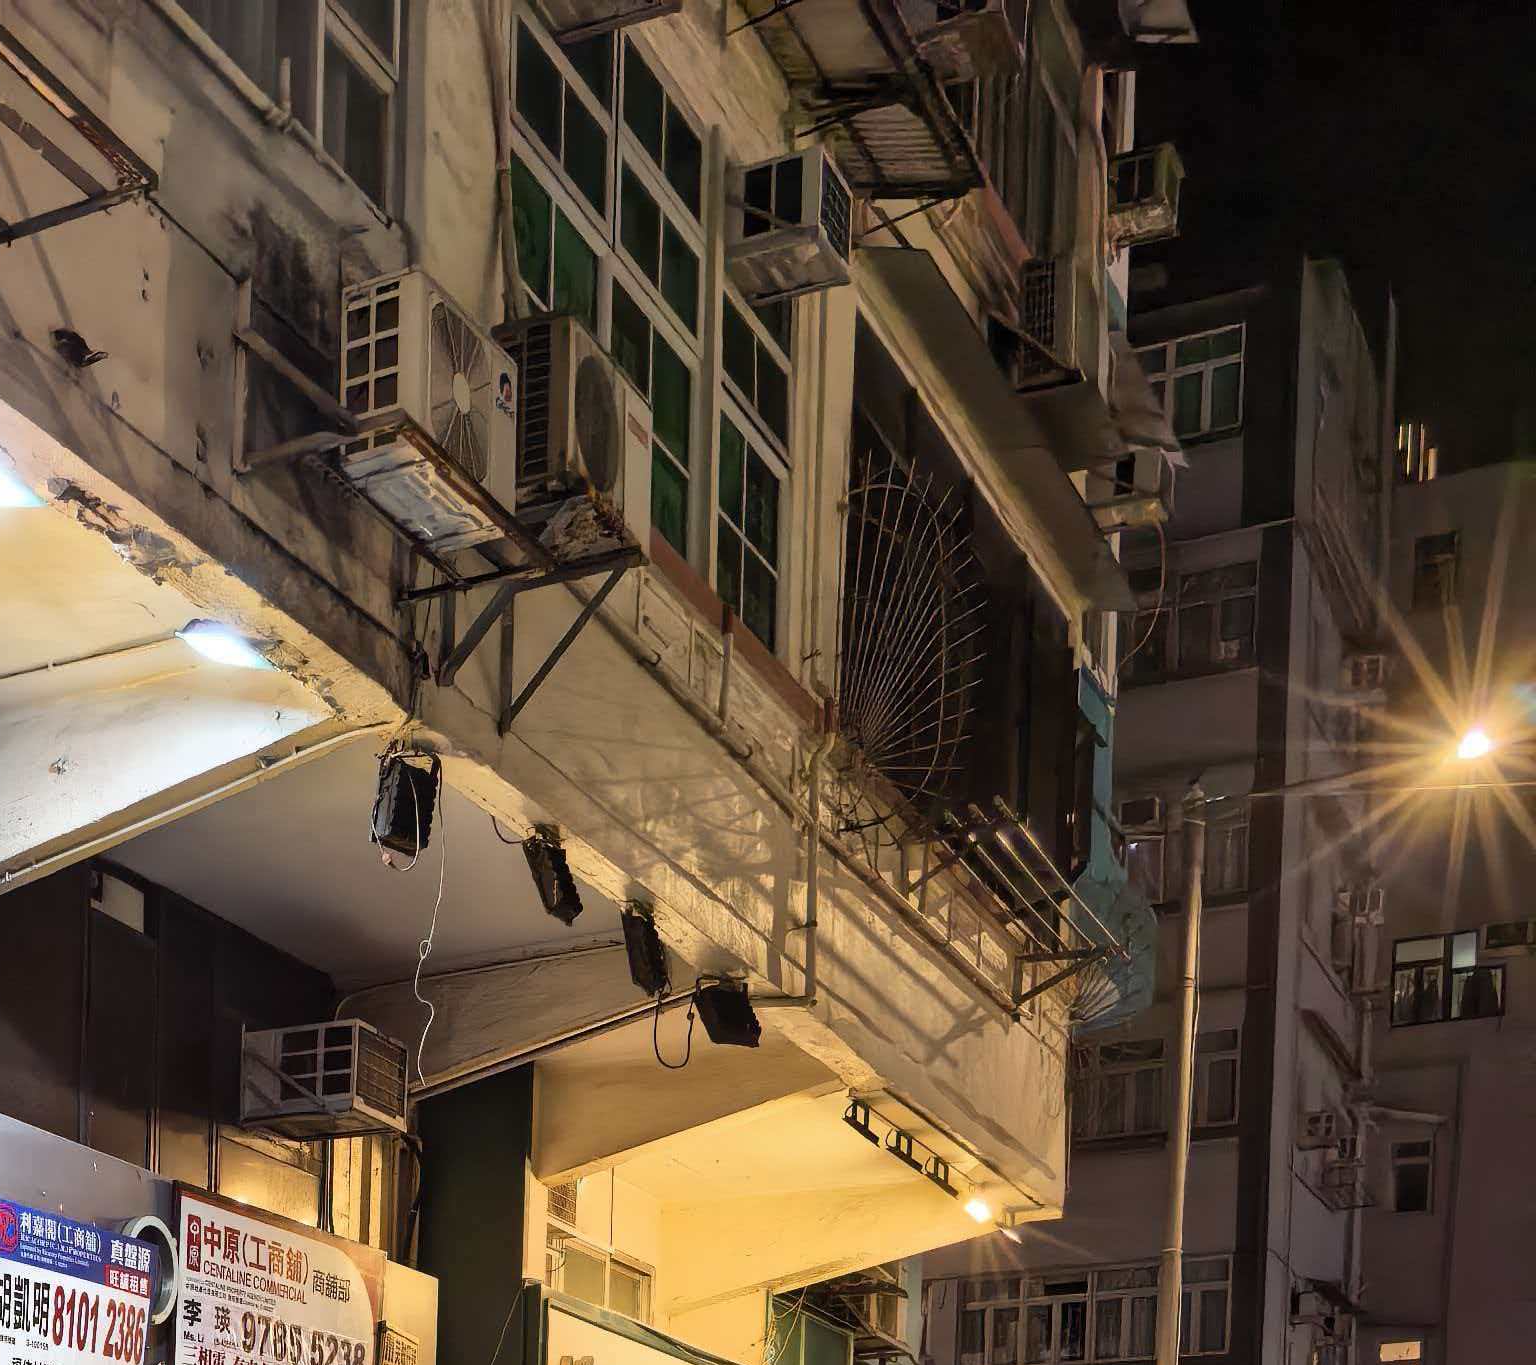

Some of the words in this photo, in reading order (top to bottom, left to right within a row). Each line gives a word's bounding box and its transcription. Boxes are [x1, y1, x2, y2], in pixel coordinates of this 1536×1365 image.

[203, 1260, 252, 1289] CENTALINE
[253, 1275, 308, 1305] COMMERCIAL
[52, 1285, 100, 1354] 8101
[102, 1301, 146, 1365] 2386
[183, 1298, 202, 1327] 李
